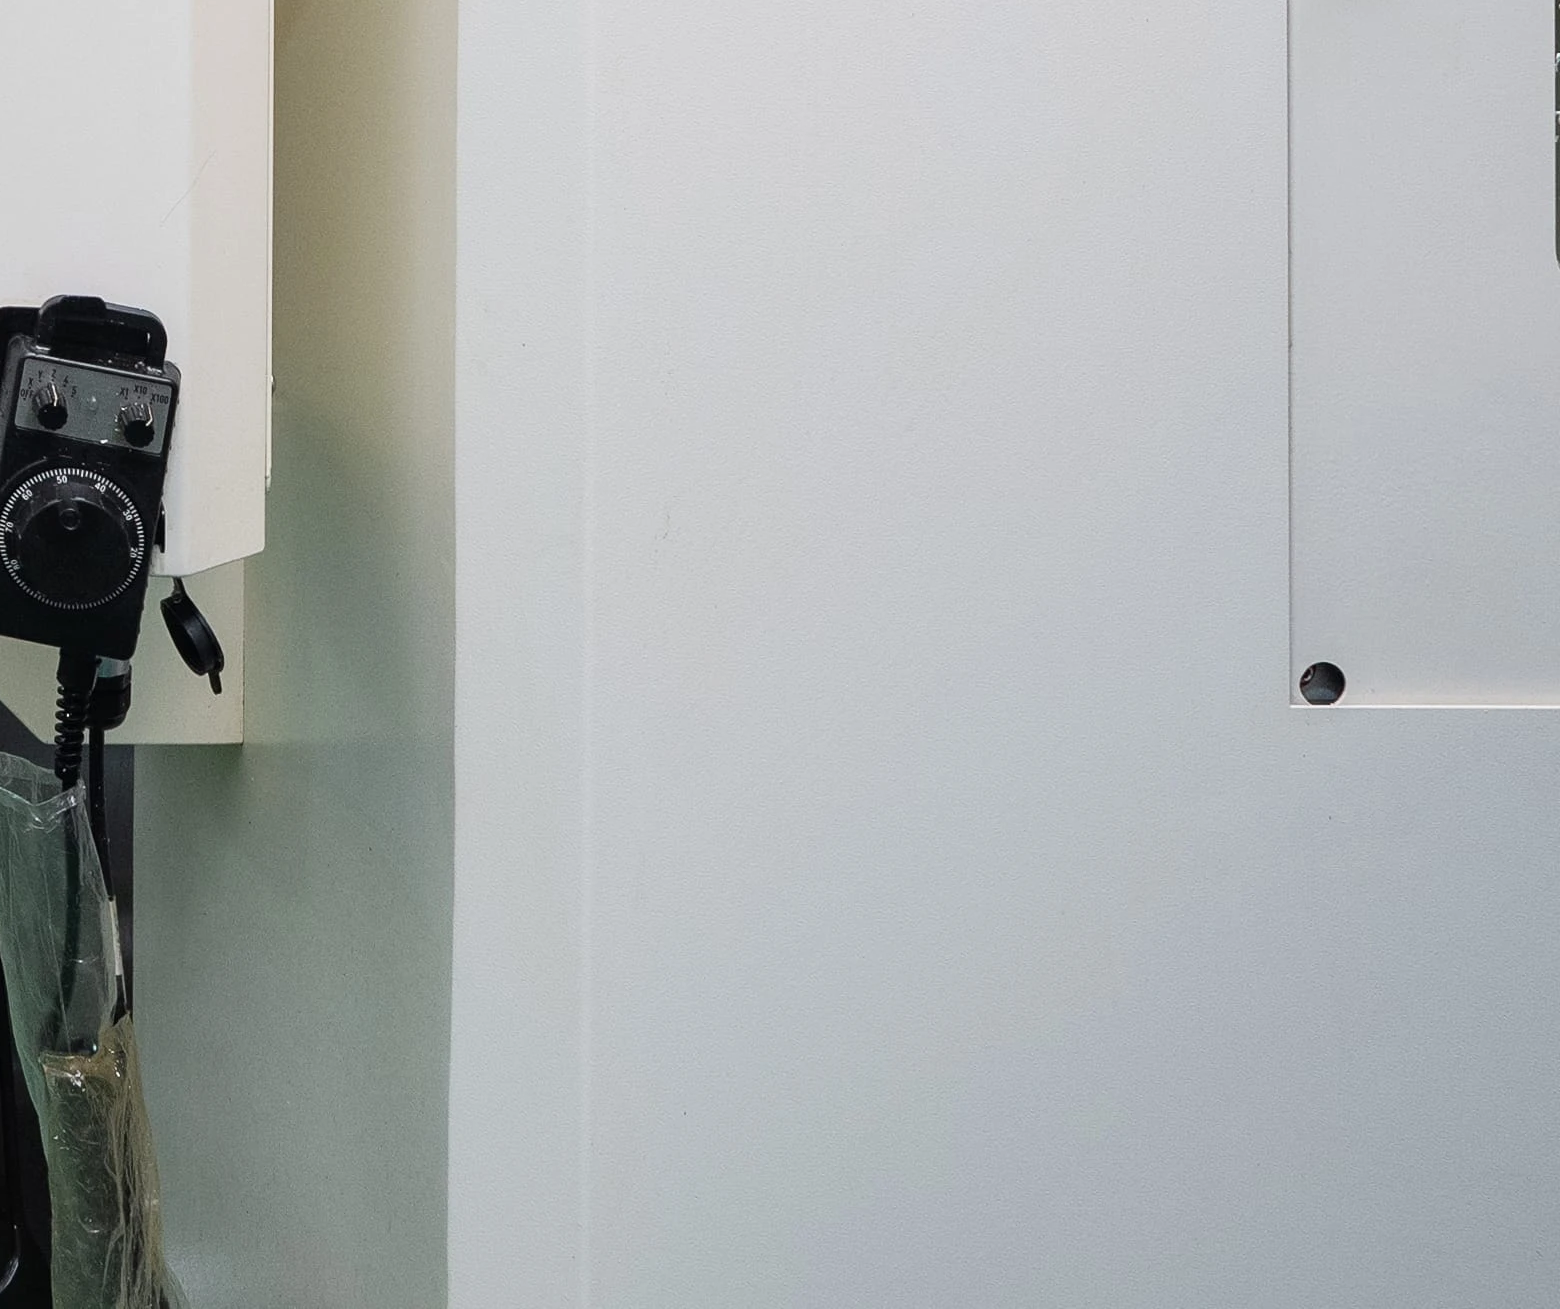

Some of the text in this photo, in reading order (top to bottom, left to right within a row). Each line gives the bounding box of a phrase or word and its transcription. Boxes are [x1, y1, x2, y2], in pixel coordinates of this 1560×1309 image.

[134, 385, 147, 394] X10
[152, 394, 168, 404] X100
[57, 476, 67, 484] 50
[95, 484, 107, 493] 40
[22, 490, 33, 500] 60
[123, 510, 132, 521] 30
[6, 522, 13, 533] 70
[130, 548, 137, 558] 20
